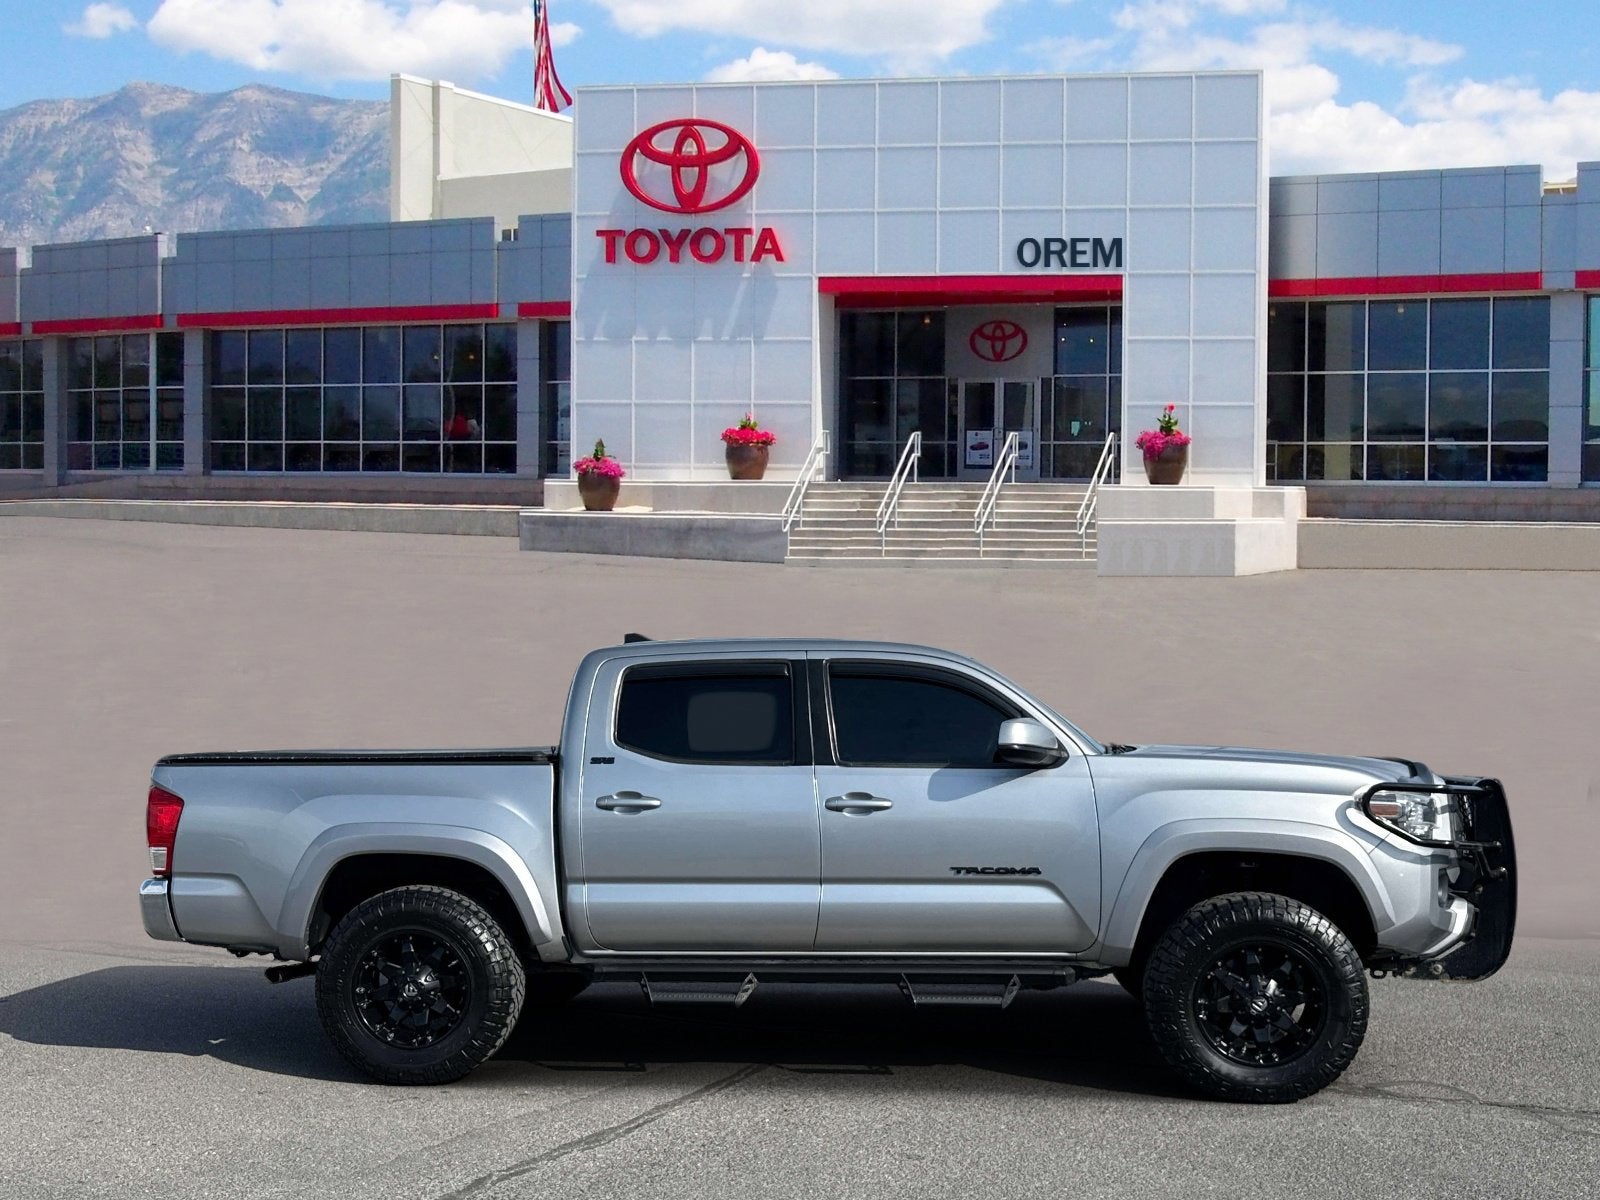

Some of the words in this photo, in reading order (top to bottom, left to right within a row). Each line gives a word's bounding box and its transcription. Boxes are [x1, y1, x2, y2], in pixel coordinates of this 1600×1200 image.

[596, 227, 785, 264] TOYOTA
[1017, 237, 1123, 268] OREM
[949, 866, 1042, 875] TACOMA
